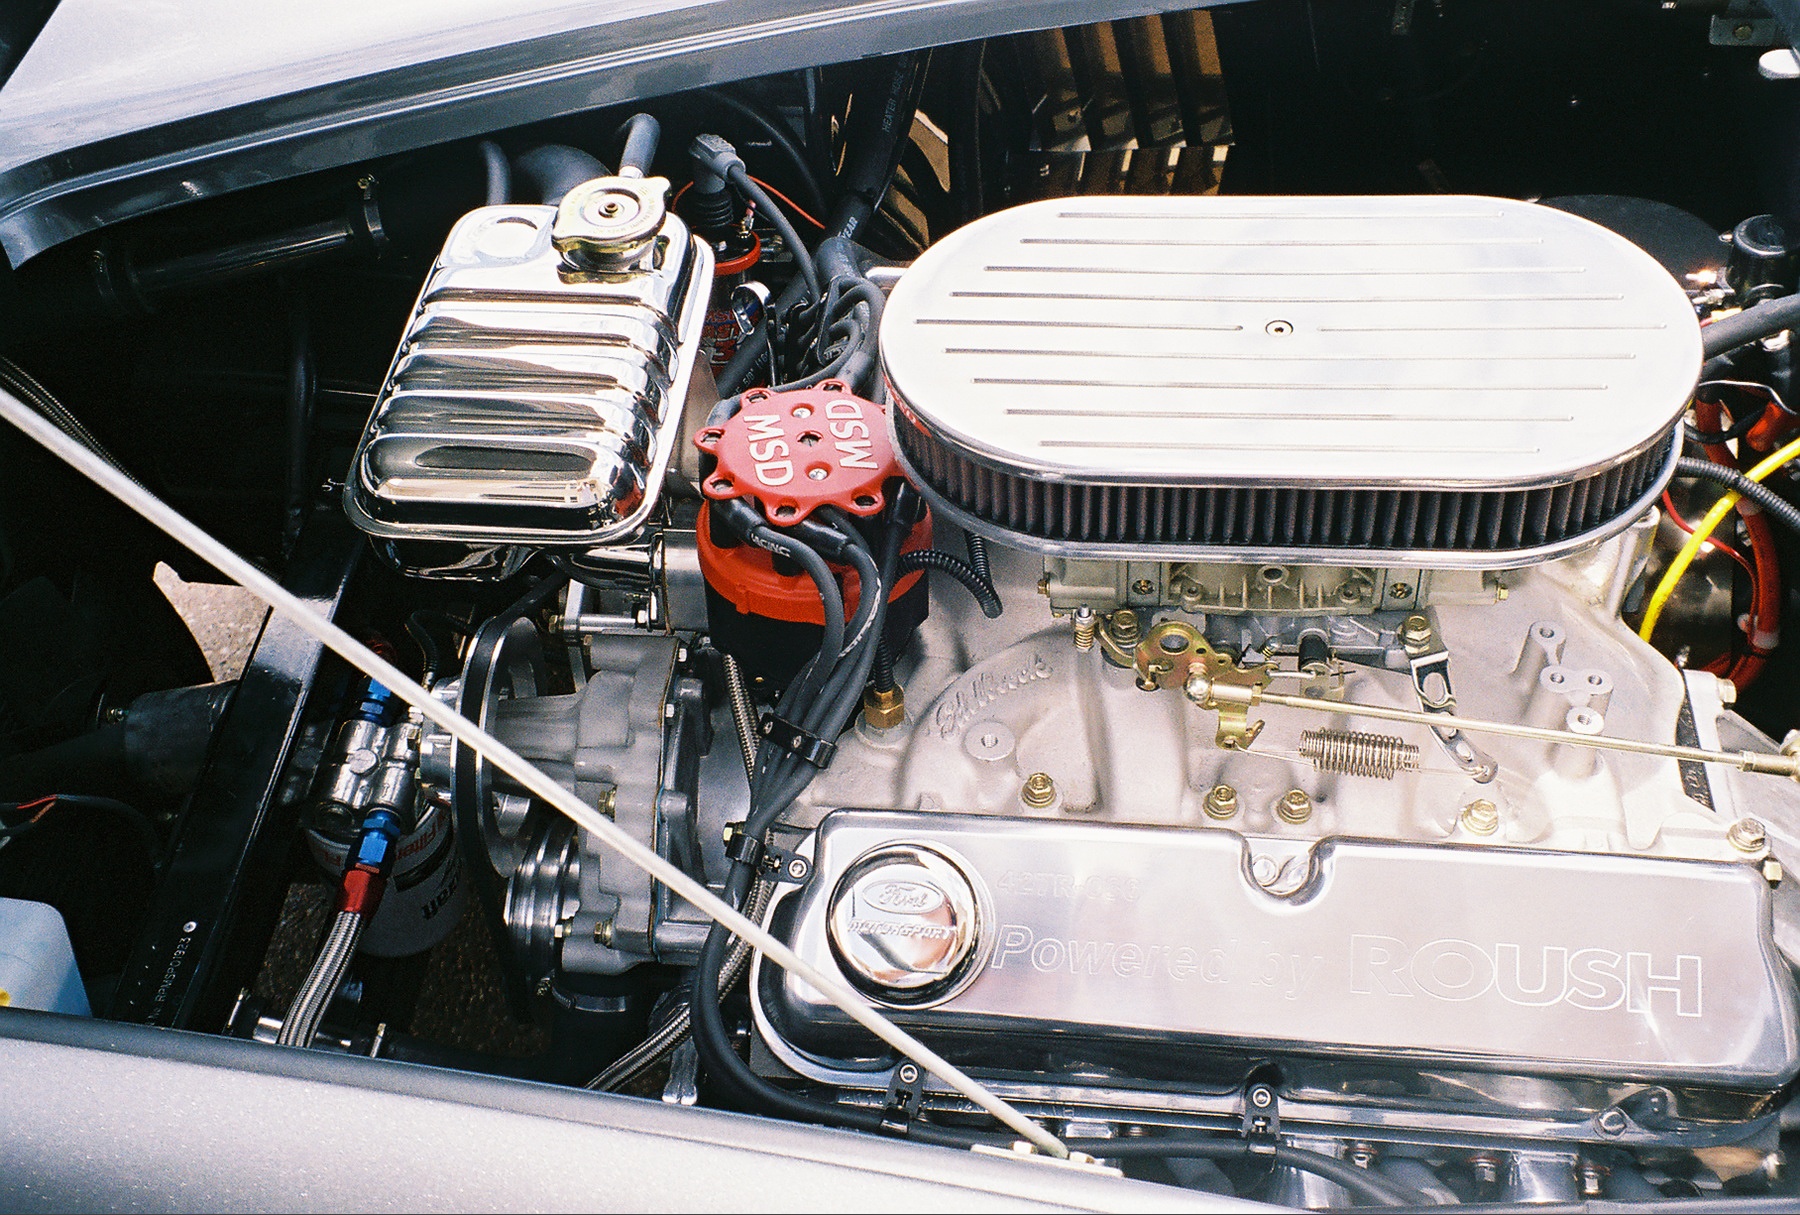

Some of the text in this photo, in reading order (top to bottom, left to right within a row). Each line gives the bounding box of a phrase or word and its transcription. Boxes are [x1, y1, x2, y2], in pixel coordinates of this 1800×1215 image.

[882, 98, 897, 133] HEATER
[743, 414, 794, 486] MSD
[825, 399, 879, 469] MSD
[879, 884, 929, 908] Ford
[848, 918, 957, 940] MOTORSPORT
[991, 924, 1702, 1018] Powered by ROUSH
